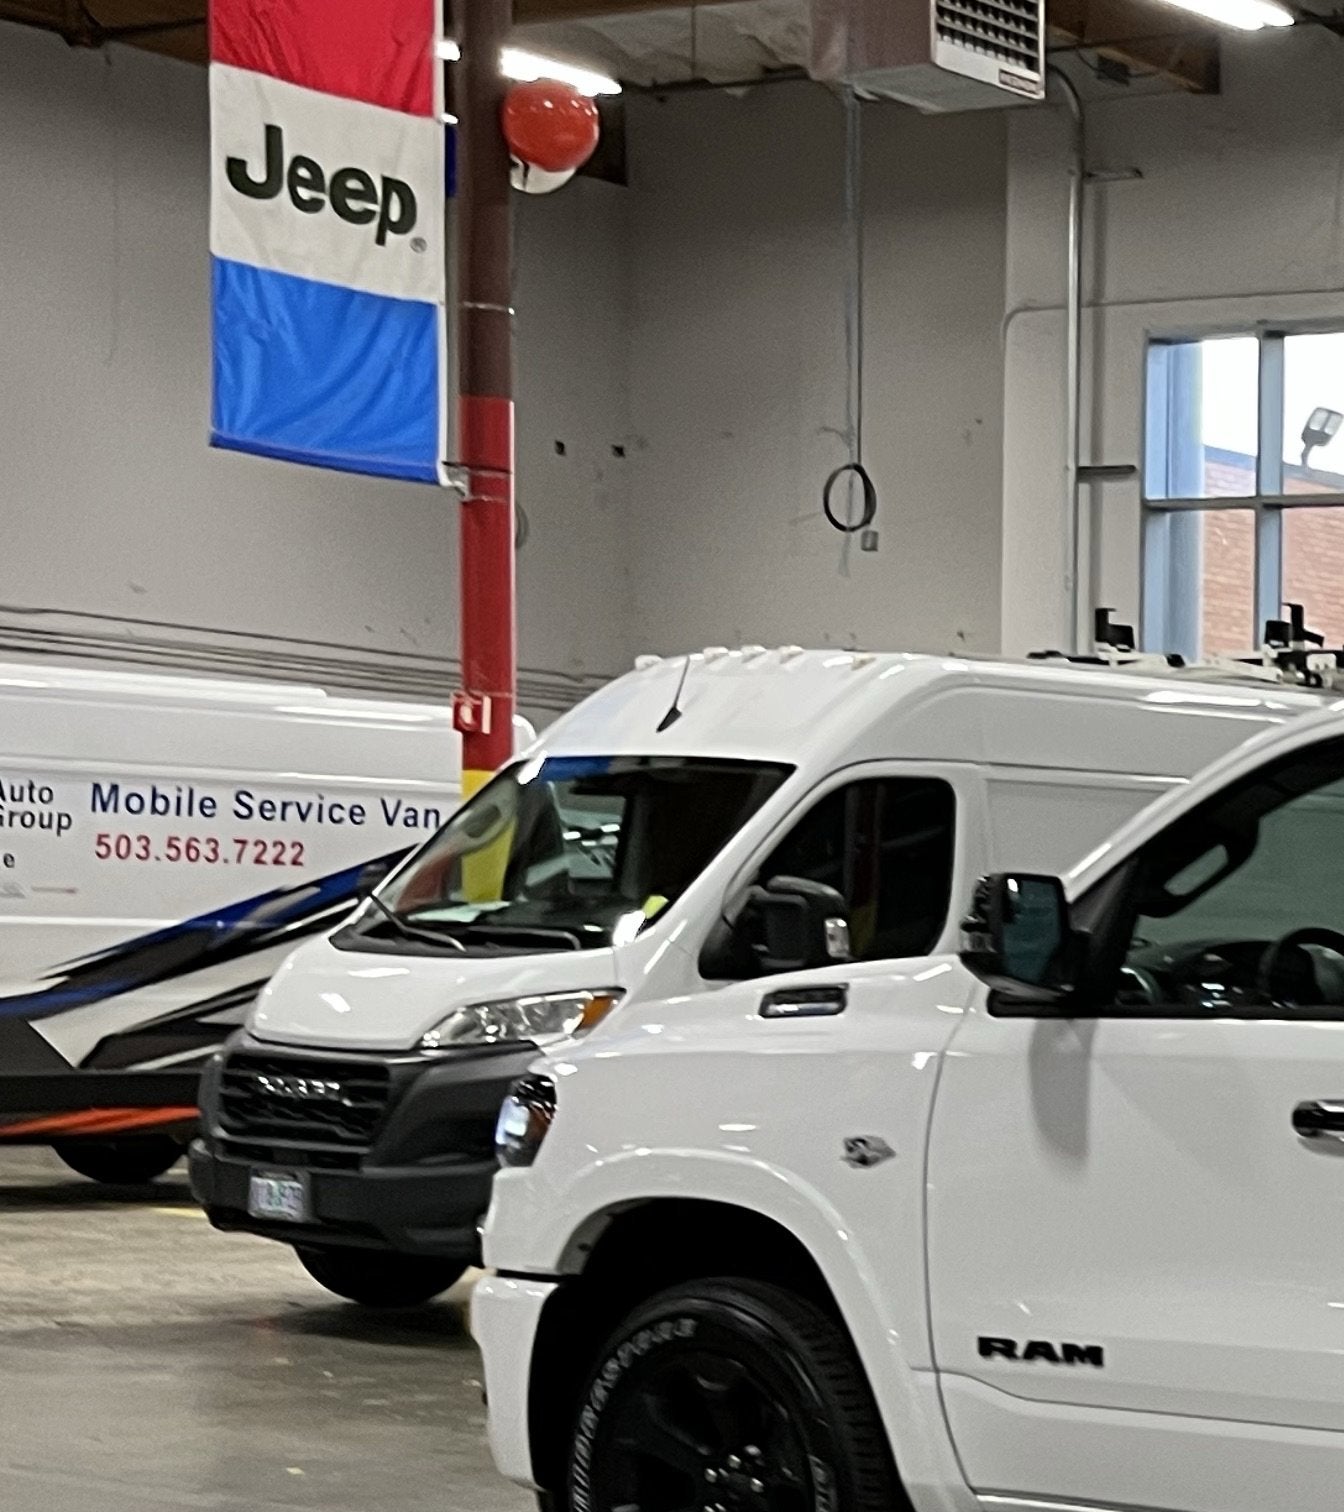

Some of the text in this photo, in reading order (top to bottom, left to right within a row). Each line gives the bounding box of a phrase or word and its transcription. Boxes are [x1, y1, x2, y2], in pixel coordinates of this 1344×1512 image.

[226, 124, 417, 246] Jeep
[90, 783, 441, 829] Mobile Service Van
[95, 834, 306, 867] 503.563.7222
[977, 1336, 1104, 1368] RAM
